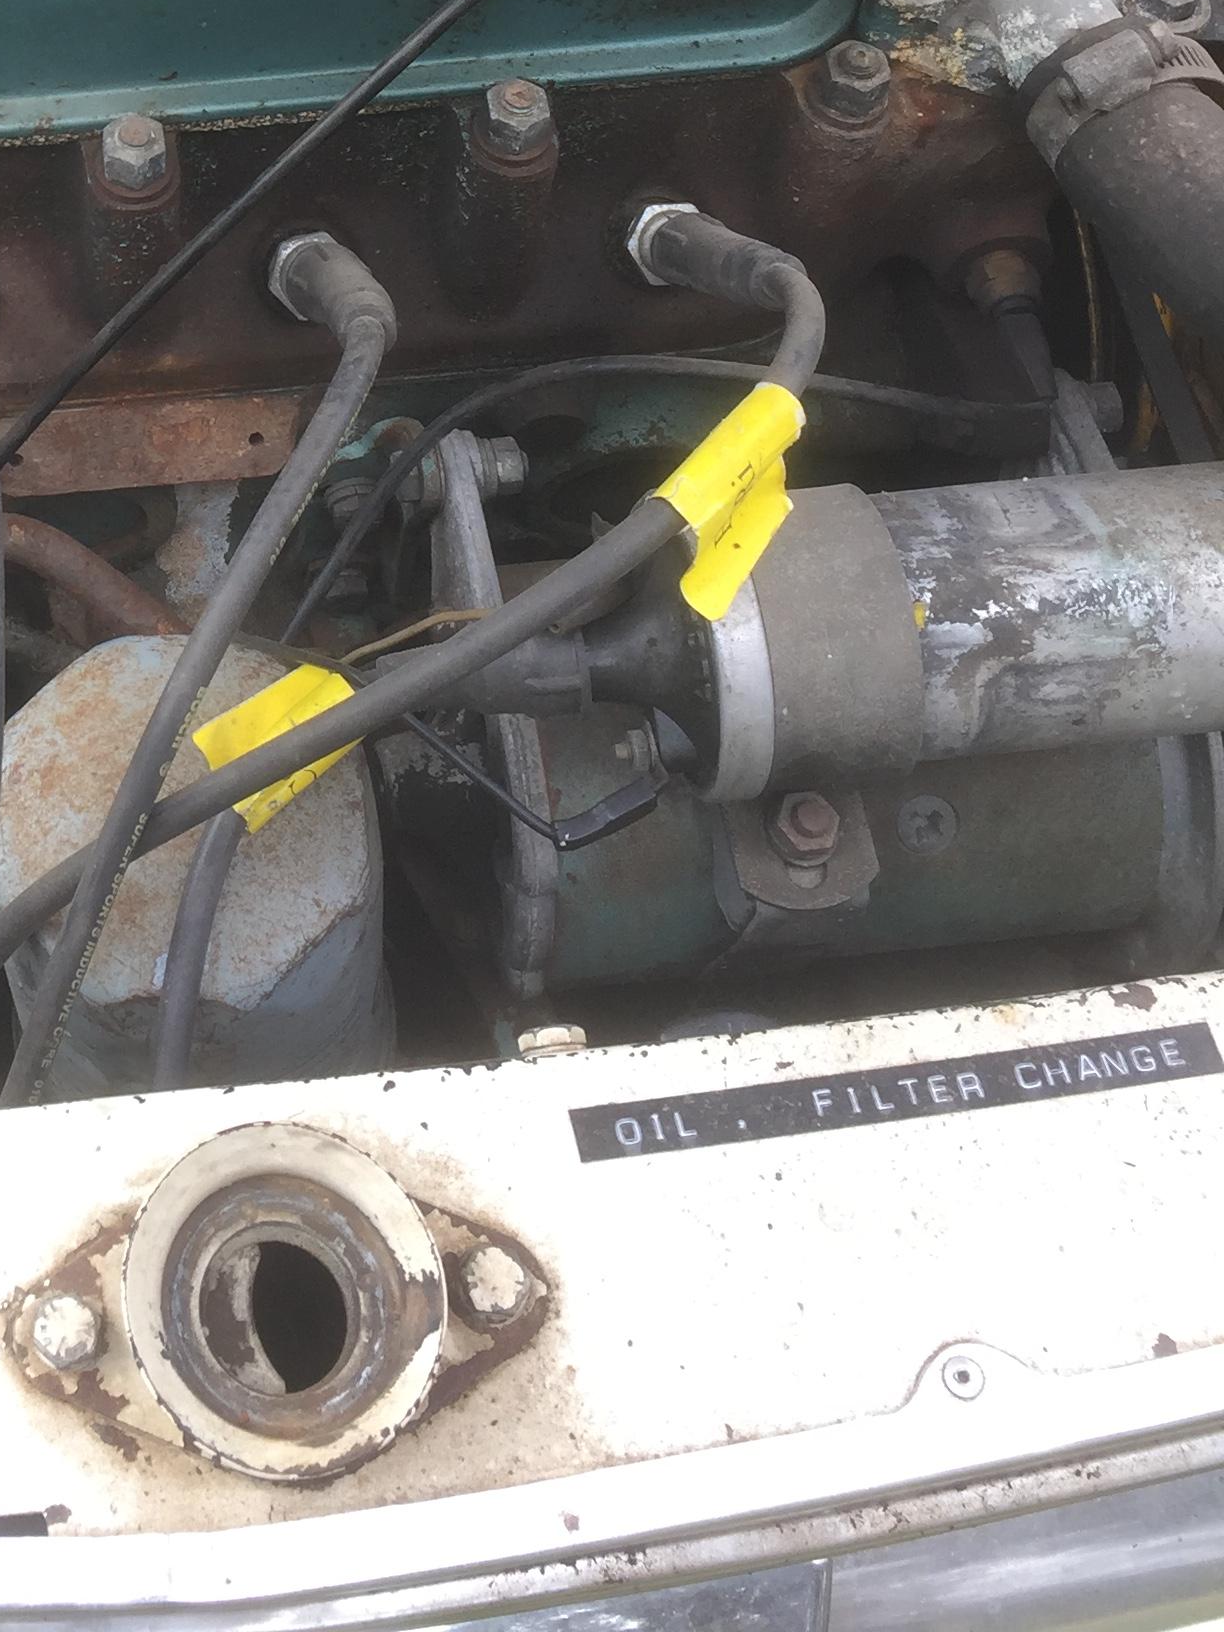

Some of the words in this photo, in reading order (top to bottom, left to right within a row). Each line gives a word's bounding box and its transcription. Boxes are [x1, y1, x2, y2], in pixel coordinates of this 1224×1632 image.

[57, 940, 96, 1024] INDUCTIVE
[614, 1112, 698, 1148] OIL
[811, 1071, 986, 1118] FILTER
[1013, 1037, 1187, 1091] CHANGE
